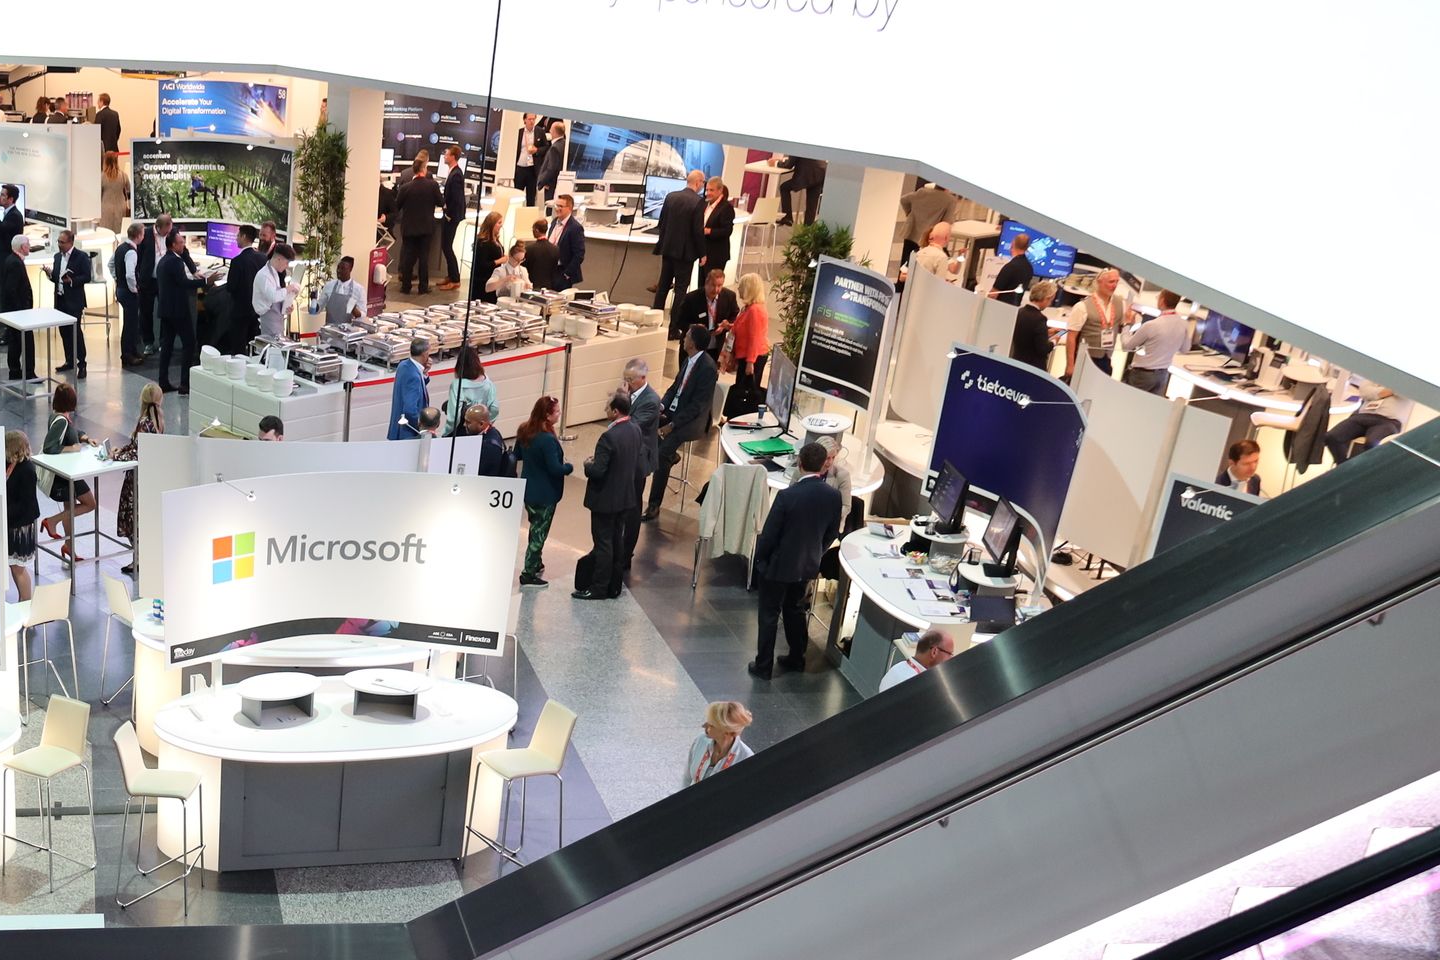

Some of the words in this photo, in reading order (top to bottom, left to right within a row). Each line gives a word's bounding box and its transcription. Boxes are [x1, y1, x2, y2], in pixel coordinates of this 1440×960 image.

[278, 89, 286, 100] 58
[162, 107, 181, 116] Digital
[282, 154, 290, 165] 44
[143, 163, 178, 172] Growing
[178, 164, 216, 172] payments
[161, 172, 192, 181] heights
[816, 306, 832, 318] FIS
[489, 490, 514, 509] 30
[1180, 497, 1233, 521] valantic
[266, 533, 427, 566] Microsoft
[465, 635, 490, 643] Finextra
